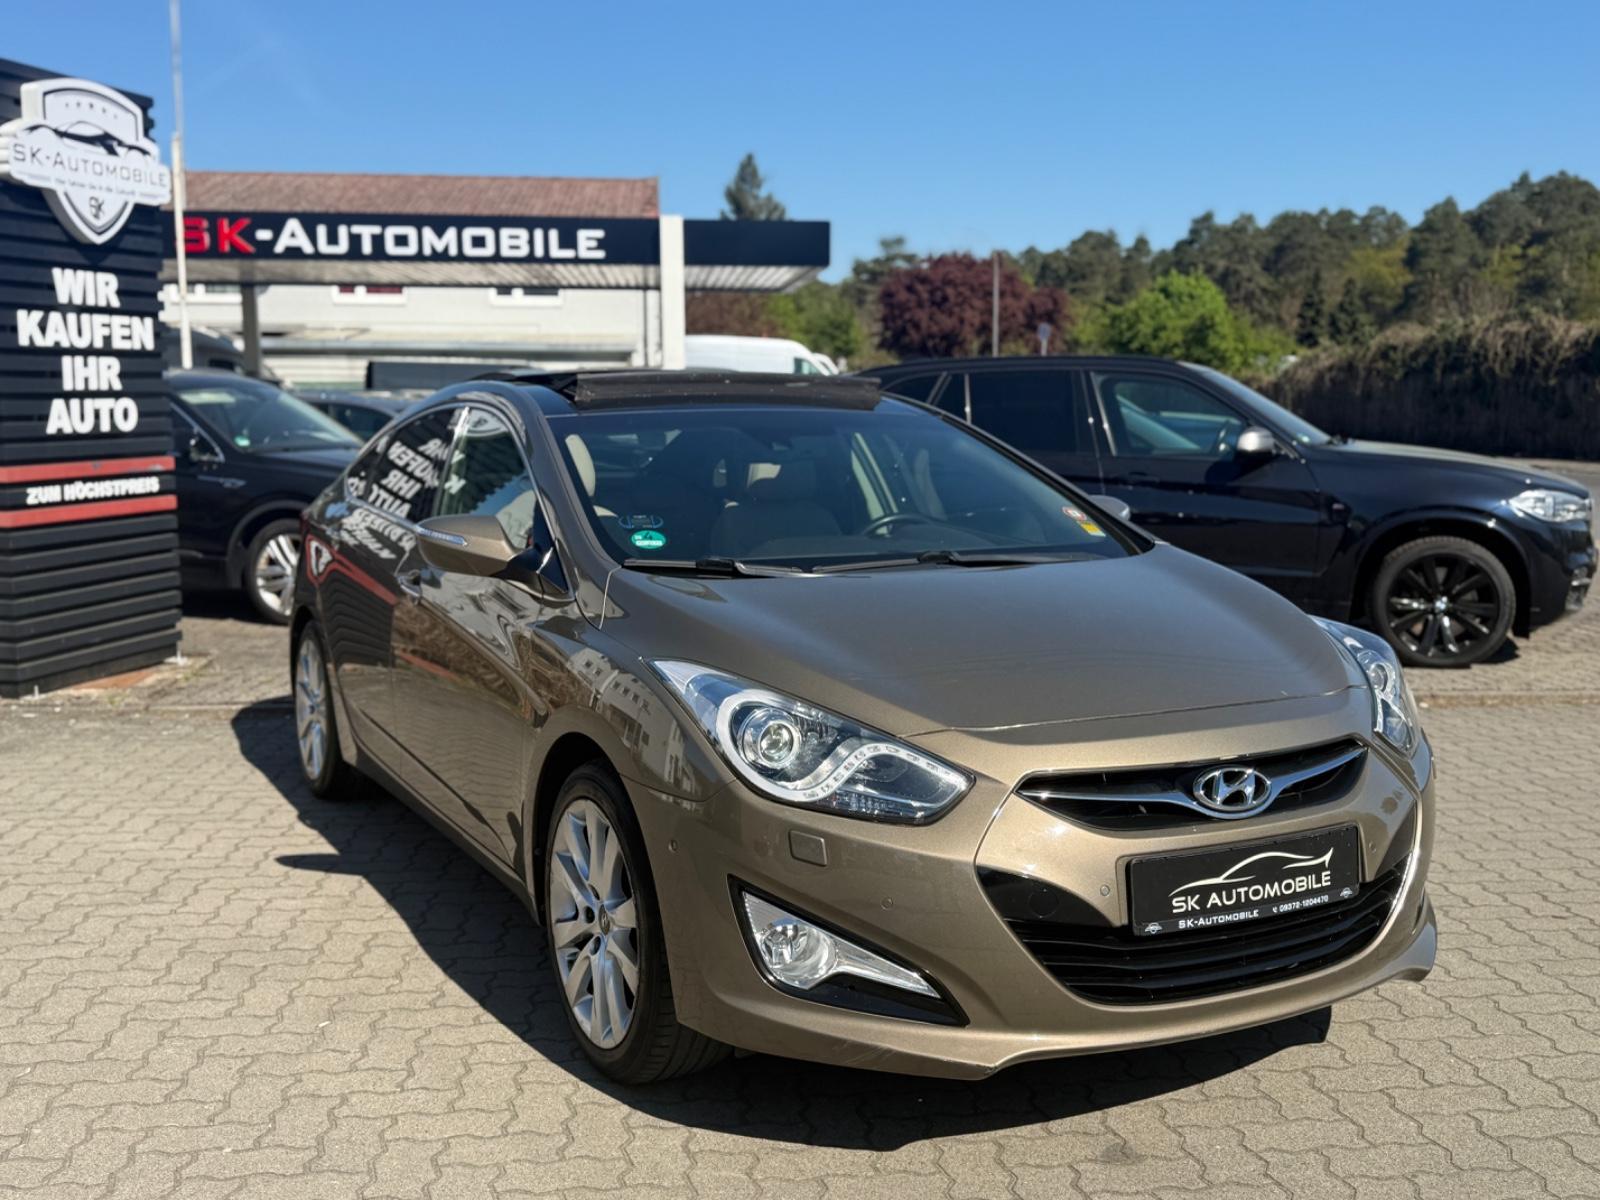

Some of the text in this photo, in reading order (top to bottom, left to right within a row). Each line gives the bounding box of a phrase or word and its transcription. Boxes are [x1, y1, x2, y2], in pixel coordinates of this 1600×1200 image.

[174, 217, 606, 260] SK-AUTOMOBILE
[51, 267, 121, 308] WIR
[16, 309, 155, 352] KAUFEN
[61, 355, 123, 392] IHR
[46, 397, 139, 435] AUTO
[26, 476, 160, 506] ZUM HÖCHSTPREIS
[1171, 870, 1331, 914] SK AUTOMOBILE
[1178, 909, 1259, 929] SK-AUTOMOBILE
